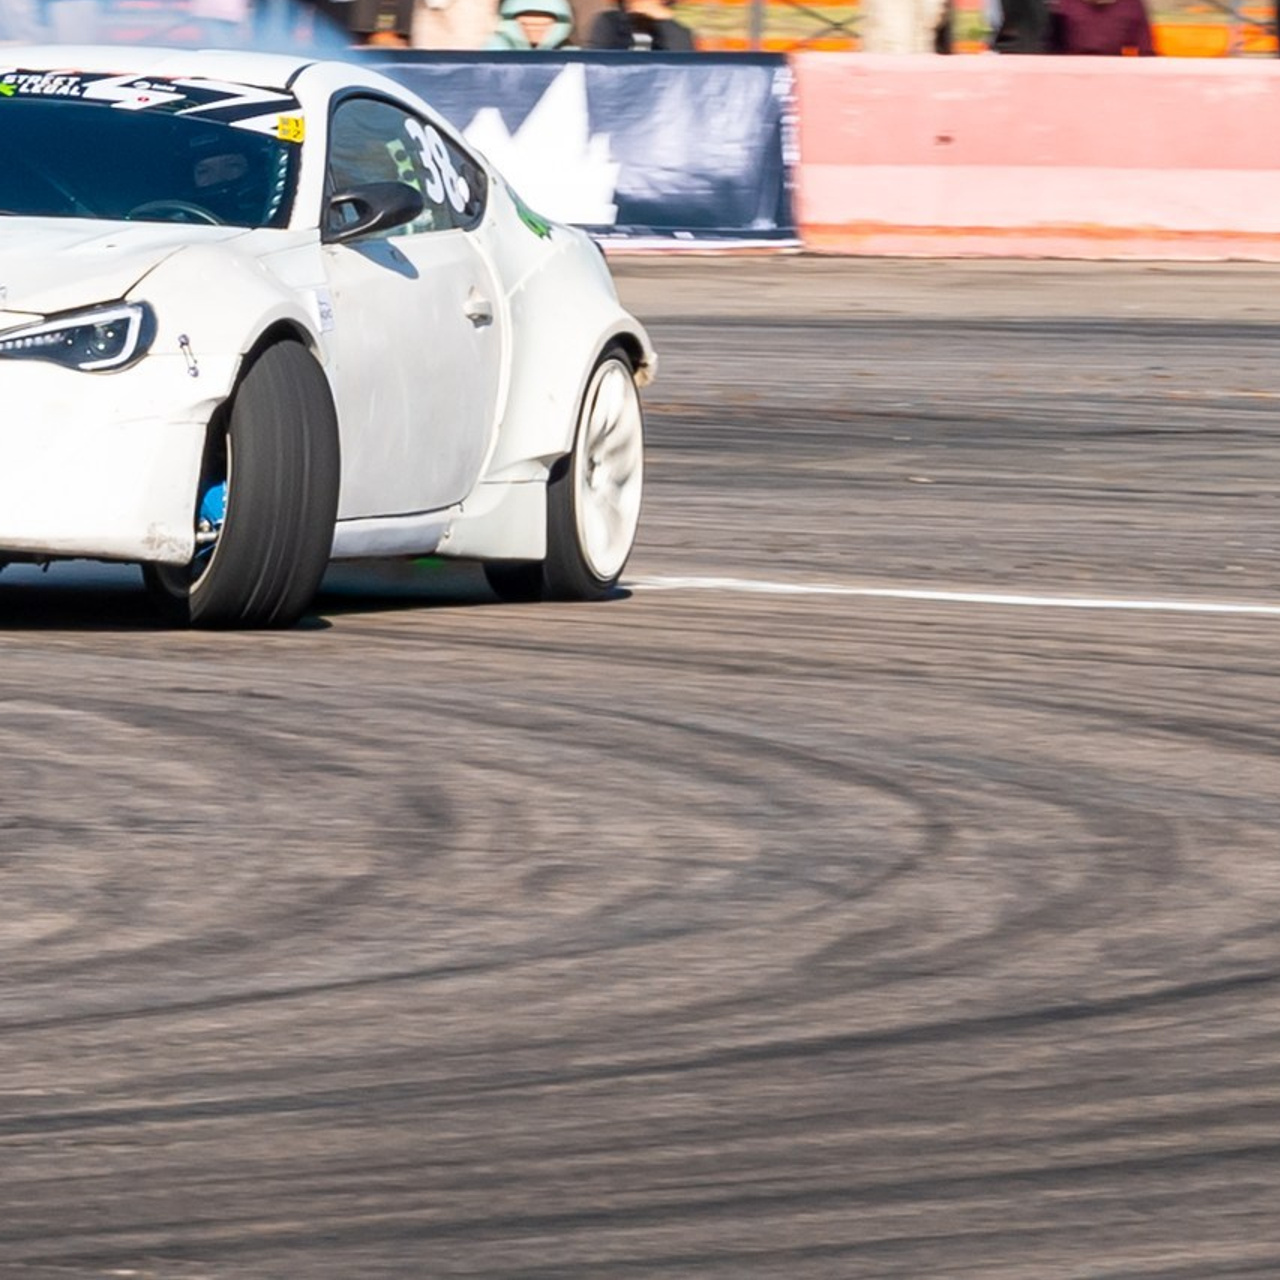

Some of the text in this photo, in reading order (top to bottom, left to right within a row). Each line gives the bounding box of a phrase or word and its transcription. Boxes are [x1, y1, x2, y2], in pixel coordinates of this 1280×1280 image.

[3, 74, 82, 86] STREET
[19, 82, 82, 96] LEGAL
[404, 118, 465, 214] 38
